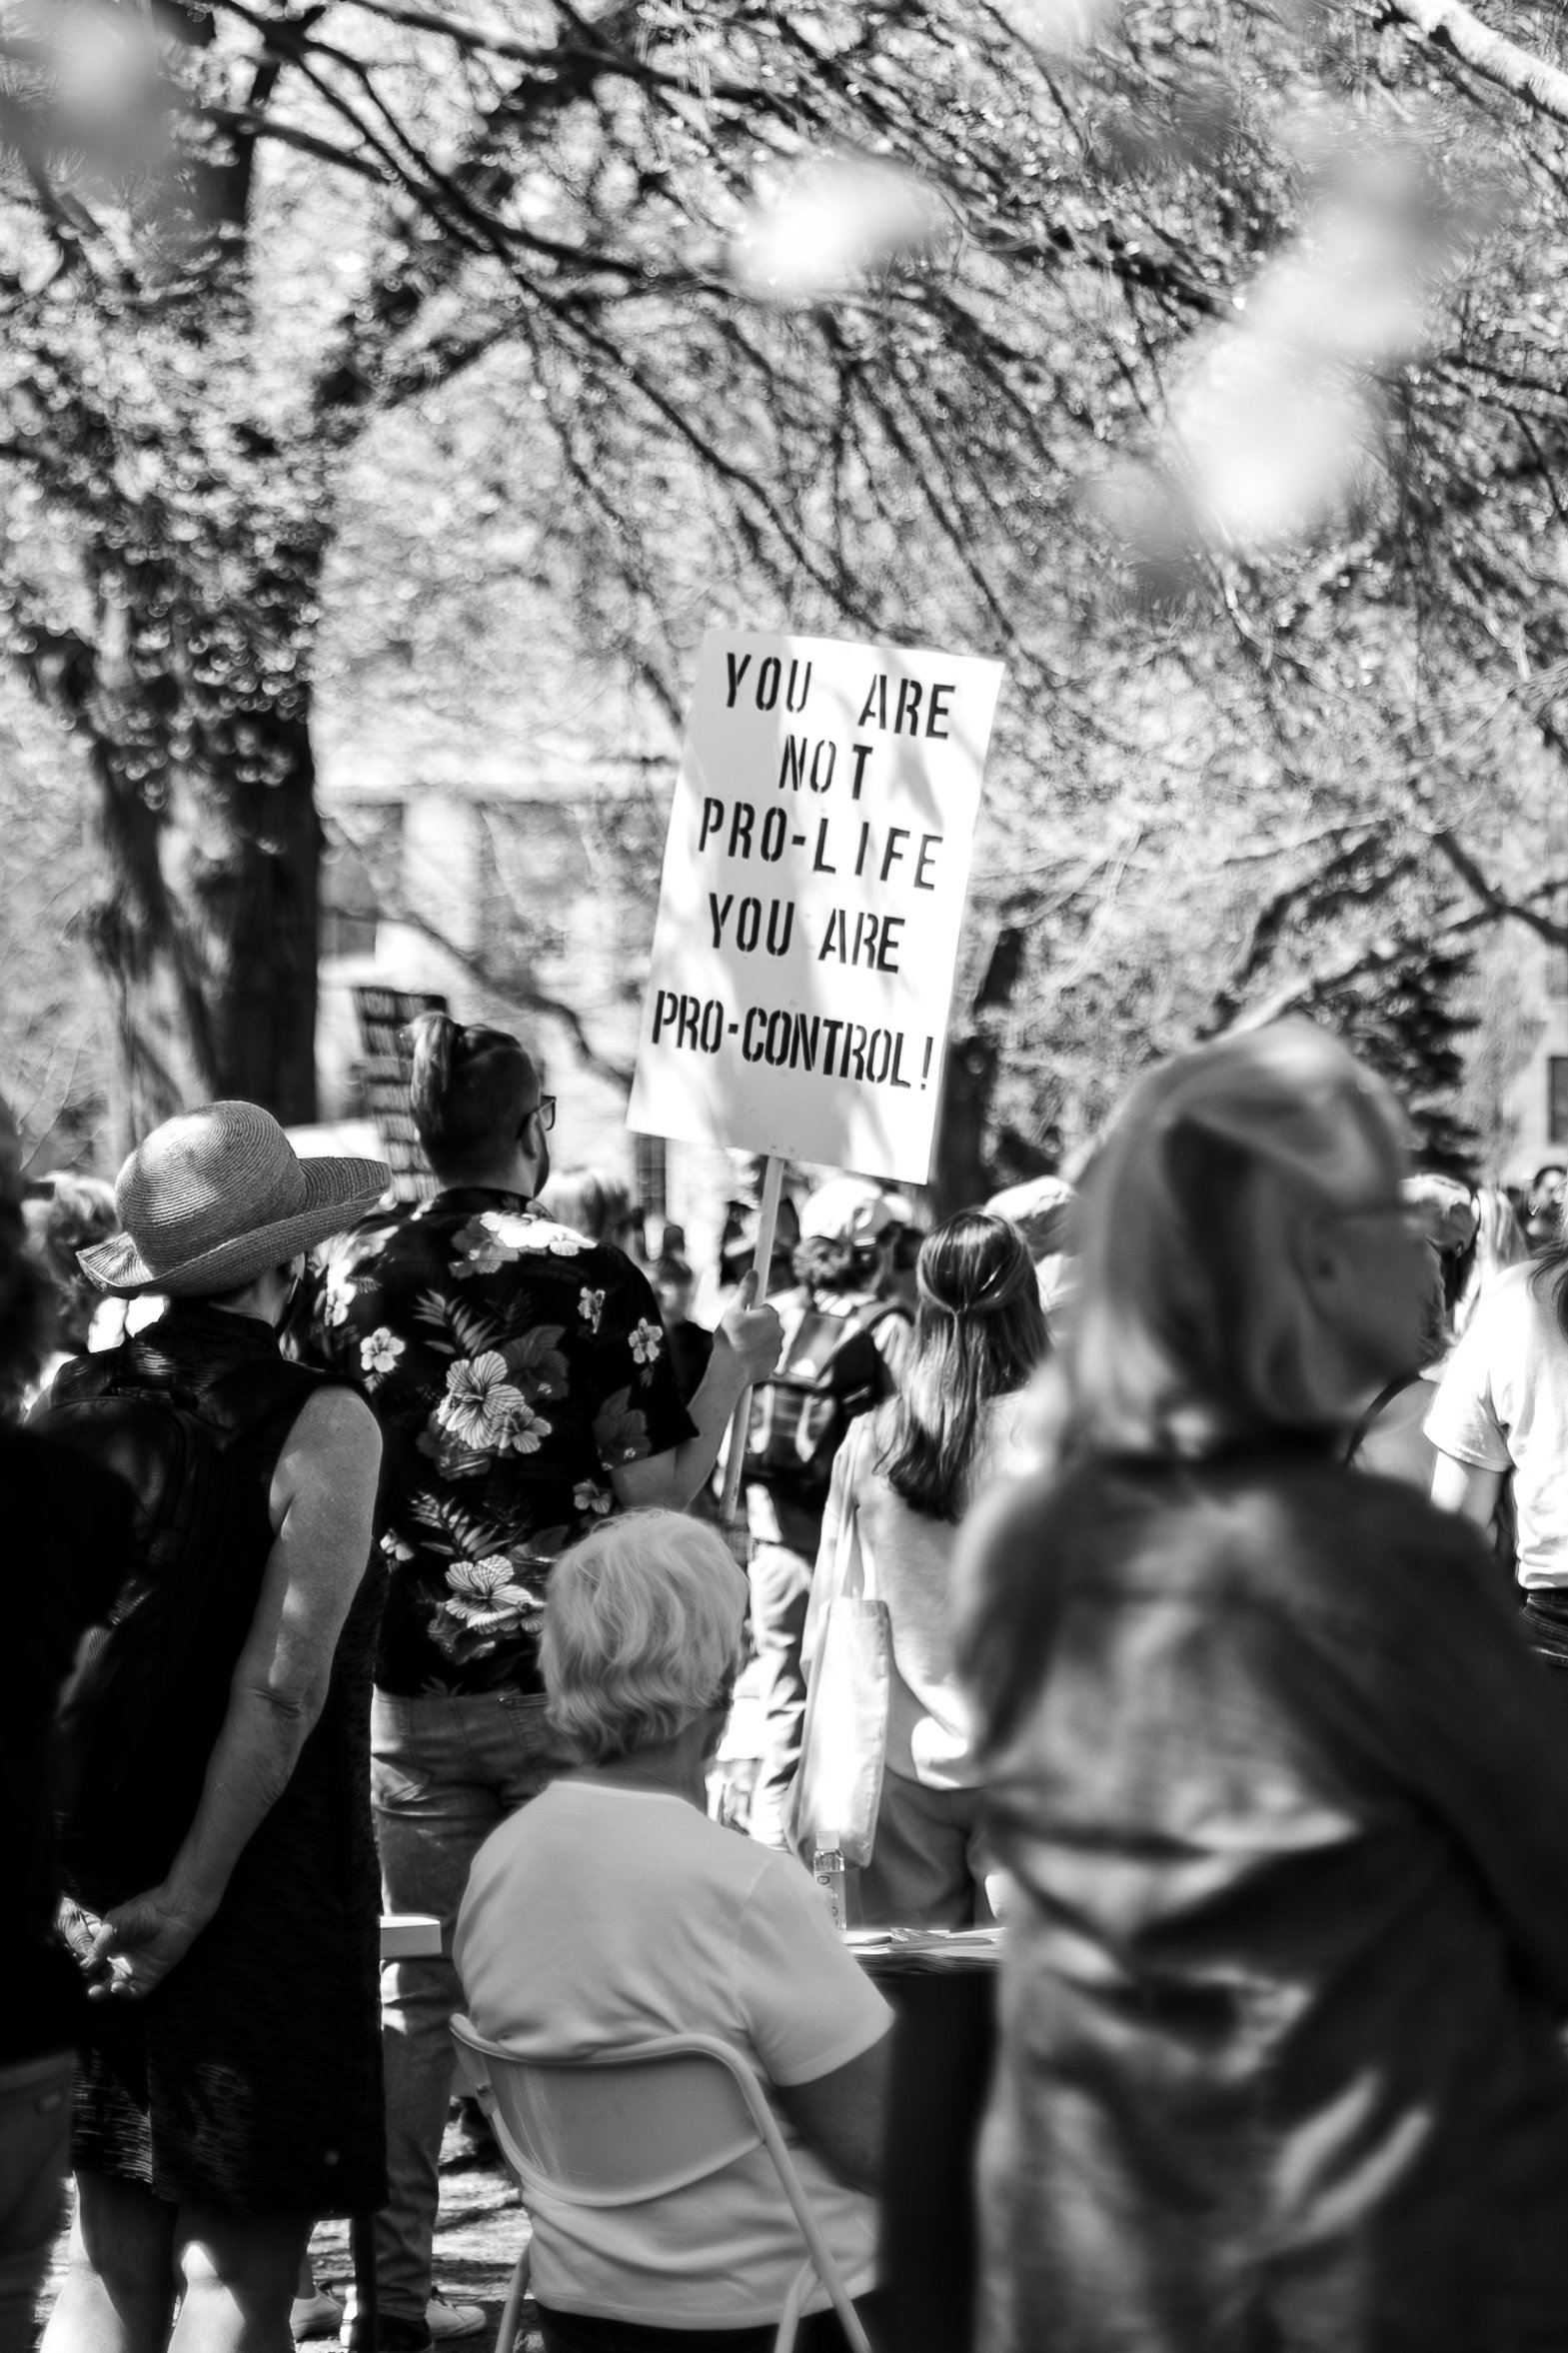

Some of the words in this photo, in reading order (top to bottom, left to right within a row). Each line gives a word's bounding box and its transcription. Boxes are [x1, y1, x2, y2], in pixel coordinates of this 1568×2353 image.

[726, 652, 812, 714] YOU
[856, 674, 956, 740] ARE
[779, 735, 874, 801] NOT
[698, 797, 944, 891] PRO-LIFE
[709, 892, 795, 957] YOU
[817, 908, 906, 974] ARE
[651, 990, 934, 1091] PRO-CONTROL!
